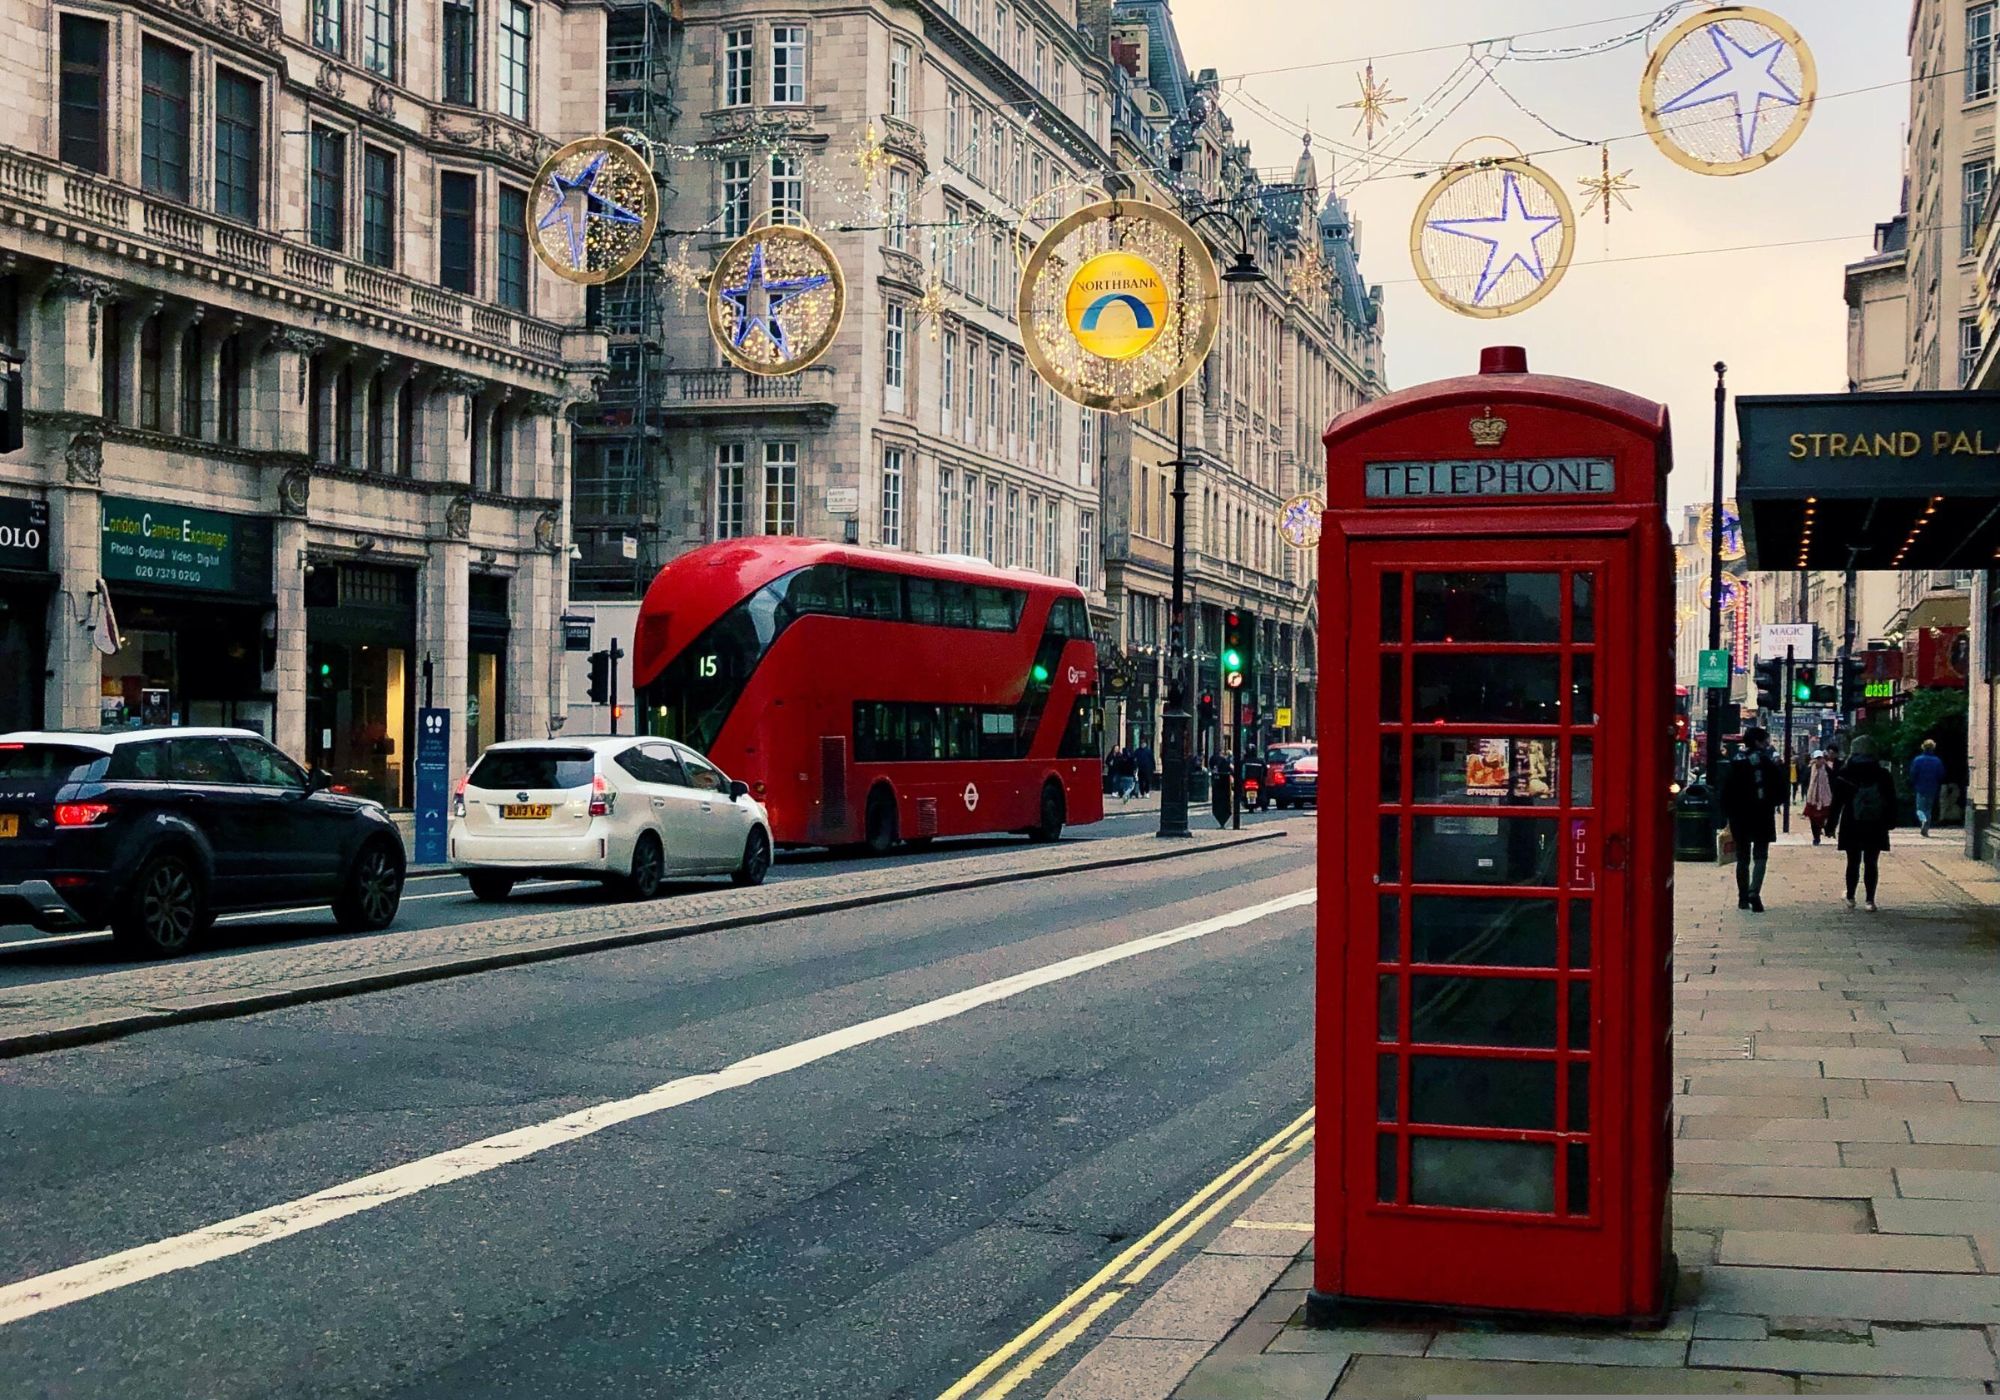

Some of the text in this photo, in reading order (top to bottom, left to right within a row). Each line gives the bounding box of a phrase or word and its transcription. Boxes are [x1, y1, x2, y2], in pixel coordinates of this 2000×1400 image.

[1076, 278, 1158, 292] NORTHBANK
[1788, 429, 2000, 458] STRAND PAL
[1375, 462, 1606, 496] TELEPHONE
[102, 507, 228, 552] London Camera Exchange
[110, 541, 220, 568] Photo Optical Video Digital
[135, 565, 154, 577] 020
[1769, 626, 1804, 637] MAGIC
[700, 655, 718, 677] 15
[1575, 828, 1587, 881] PULL
